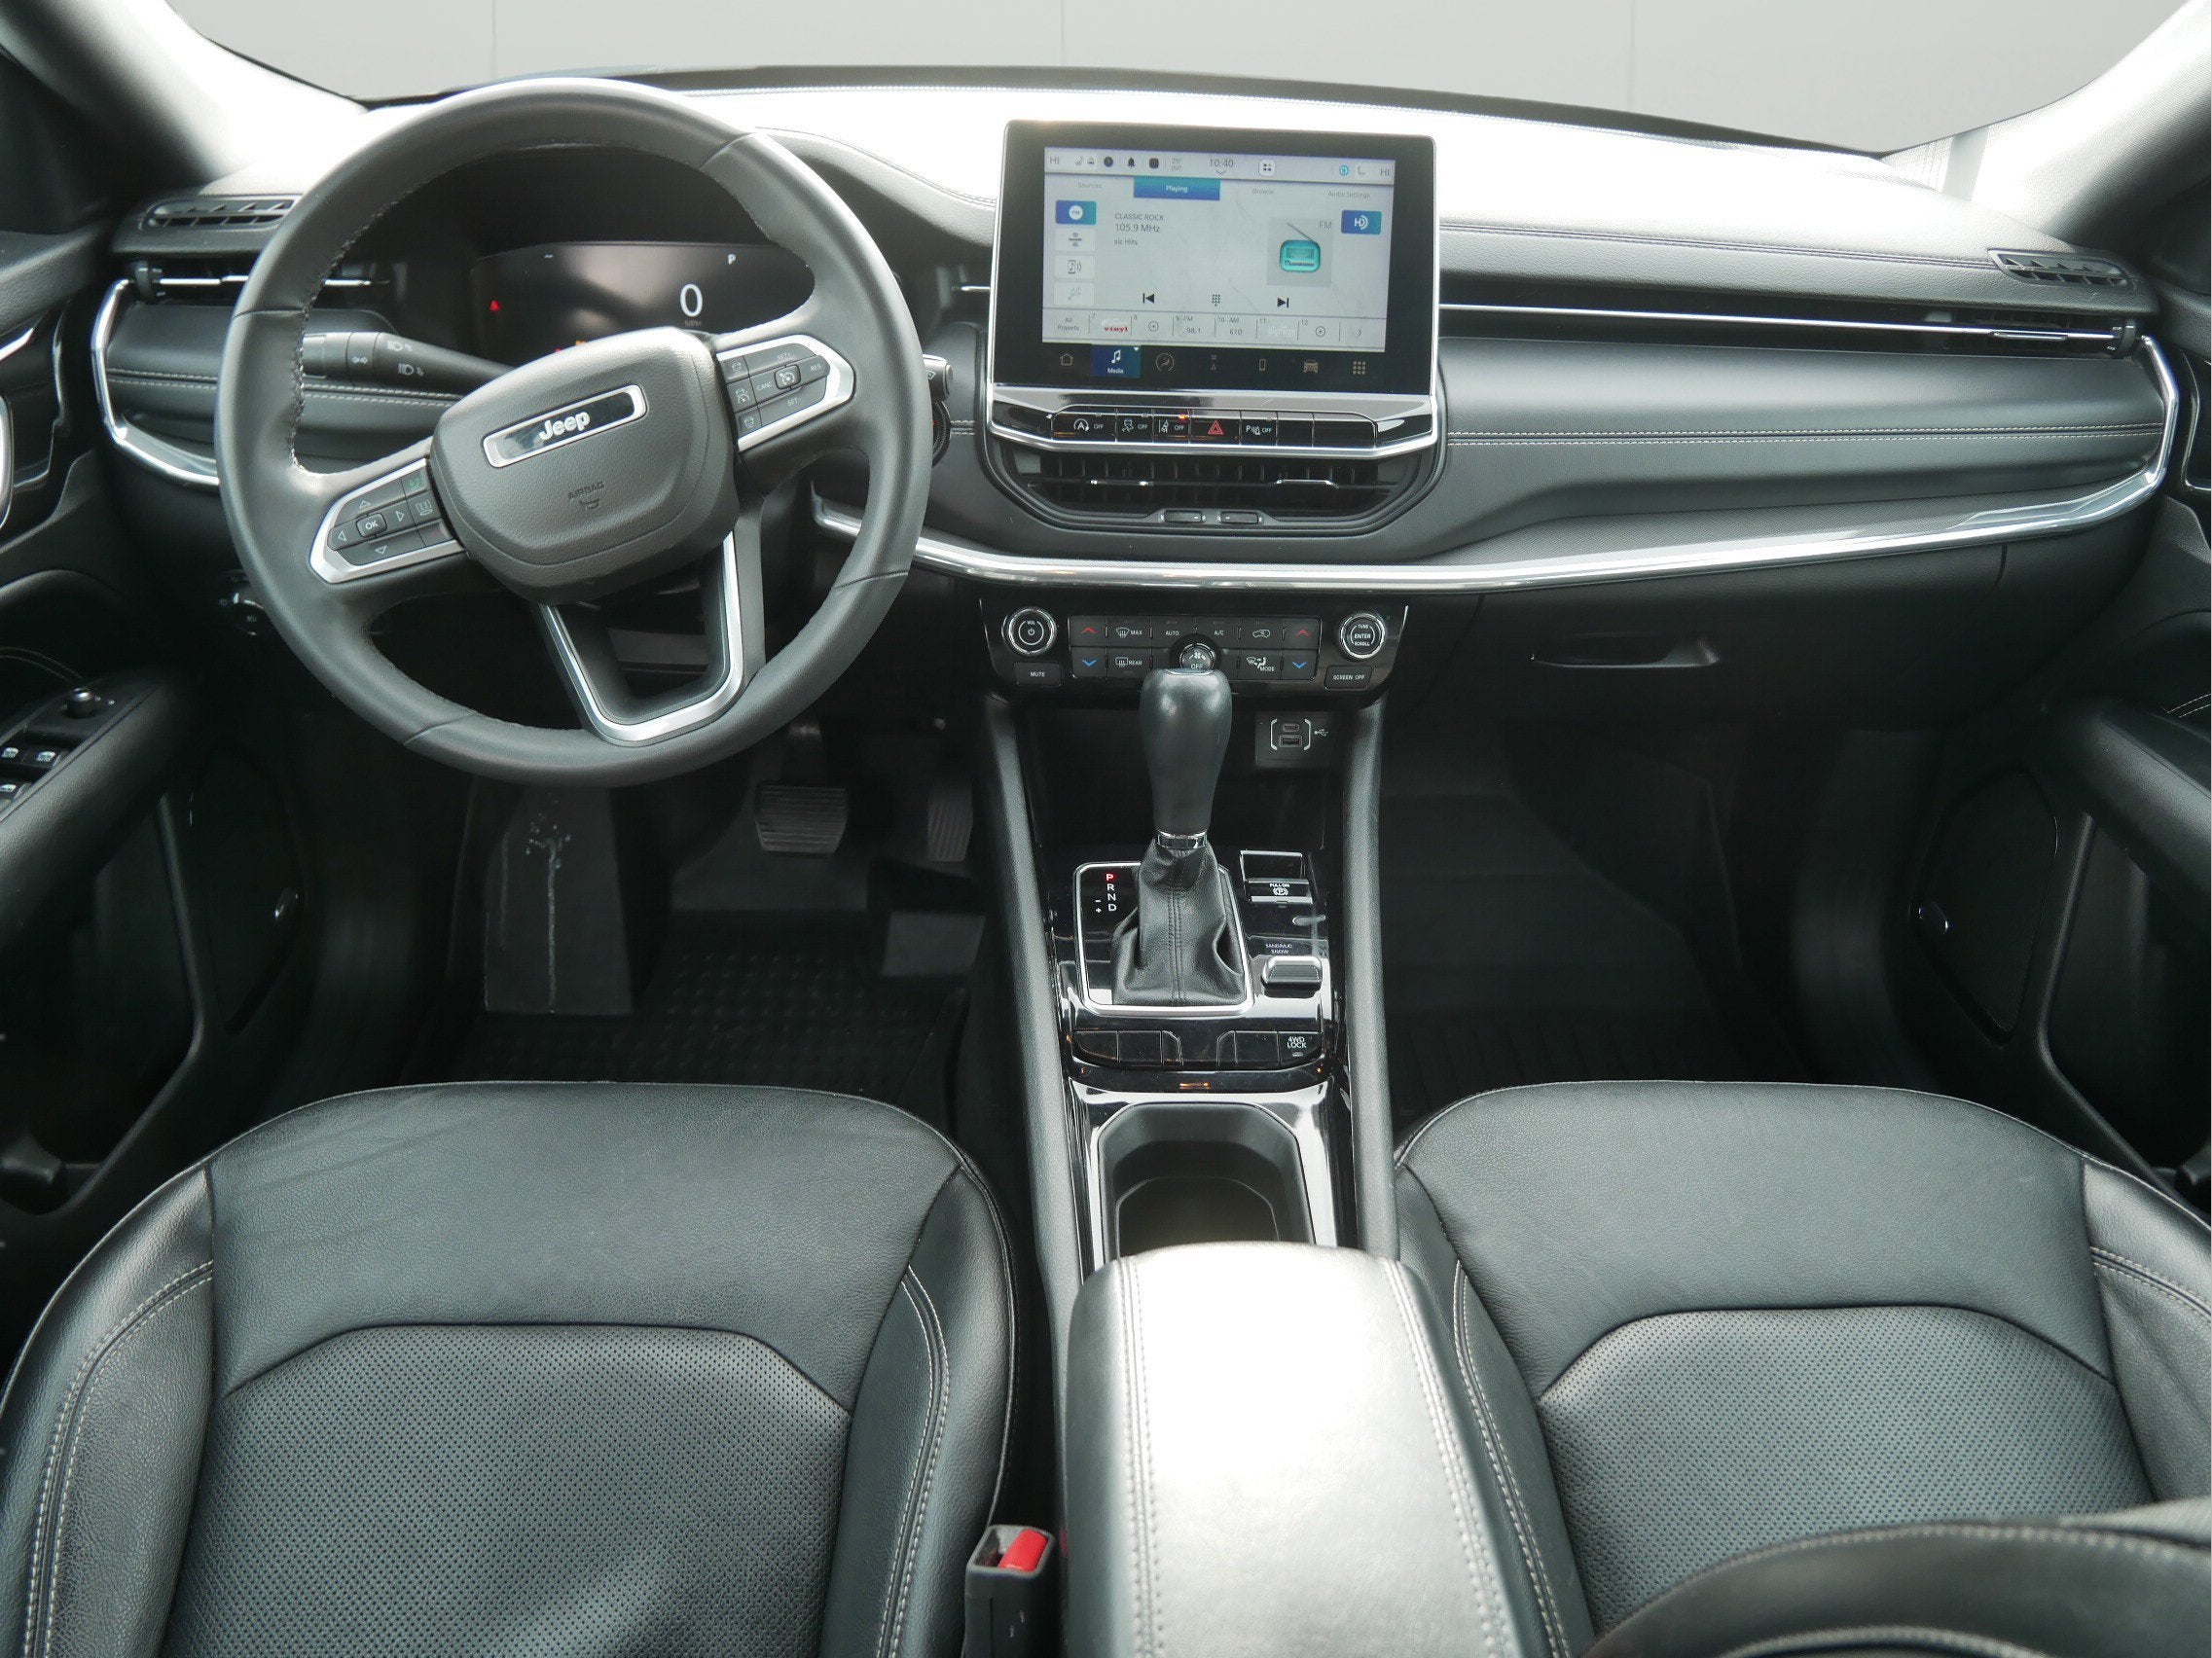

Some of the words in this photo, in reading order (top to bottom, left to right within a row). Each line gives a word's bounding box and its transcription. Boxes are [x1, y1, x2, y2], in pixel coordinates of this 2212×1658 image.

[1209, 158, 1234, 168] 10:40
[1165, 185, 1188, 193] Playing
[1115, 223, 1139, 232] 105.9
[1141, 224, 1160, 233] MHz
[1319, 220, 1332, 229] FM
[727, 253, 736, 265] P
[680, 284, 703, 317] 0
[538, 412, 591, 441] Jeep
[365, 520, 379, 530] OK
[1106, 873, 1114, 881] P
[1107, 893, 1116, 901] N
